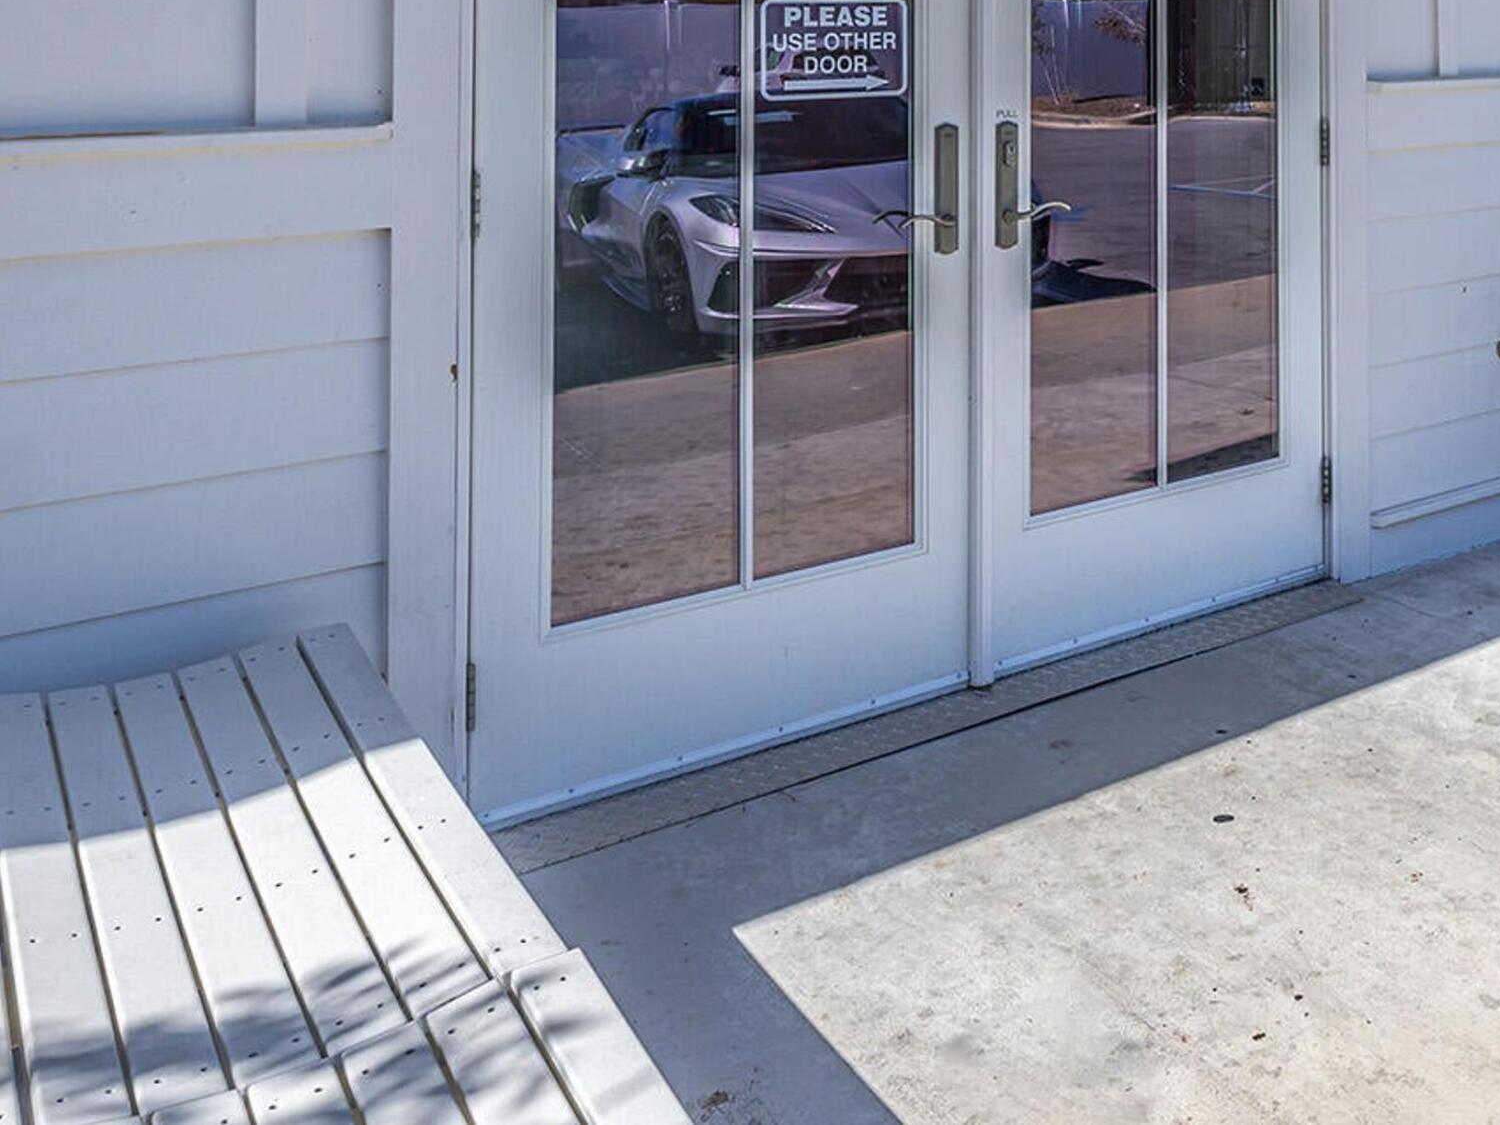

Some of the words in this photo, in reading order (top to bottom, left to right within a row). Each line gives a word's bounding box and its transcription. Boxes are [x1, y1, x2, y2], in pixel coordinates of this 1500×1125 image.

[784, 6, 888, 28] PLEASE
[772, 33, 816, 53] USE
[824, 32, 897, 50] OTHER
[804, 55, 868, 74] DOOR
[995, 109, 1018, 119] PULL
